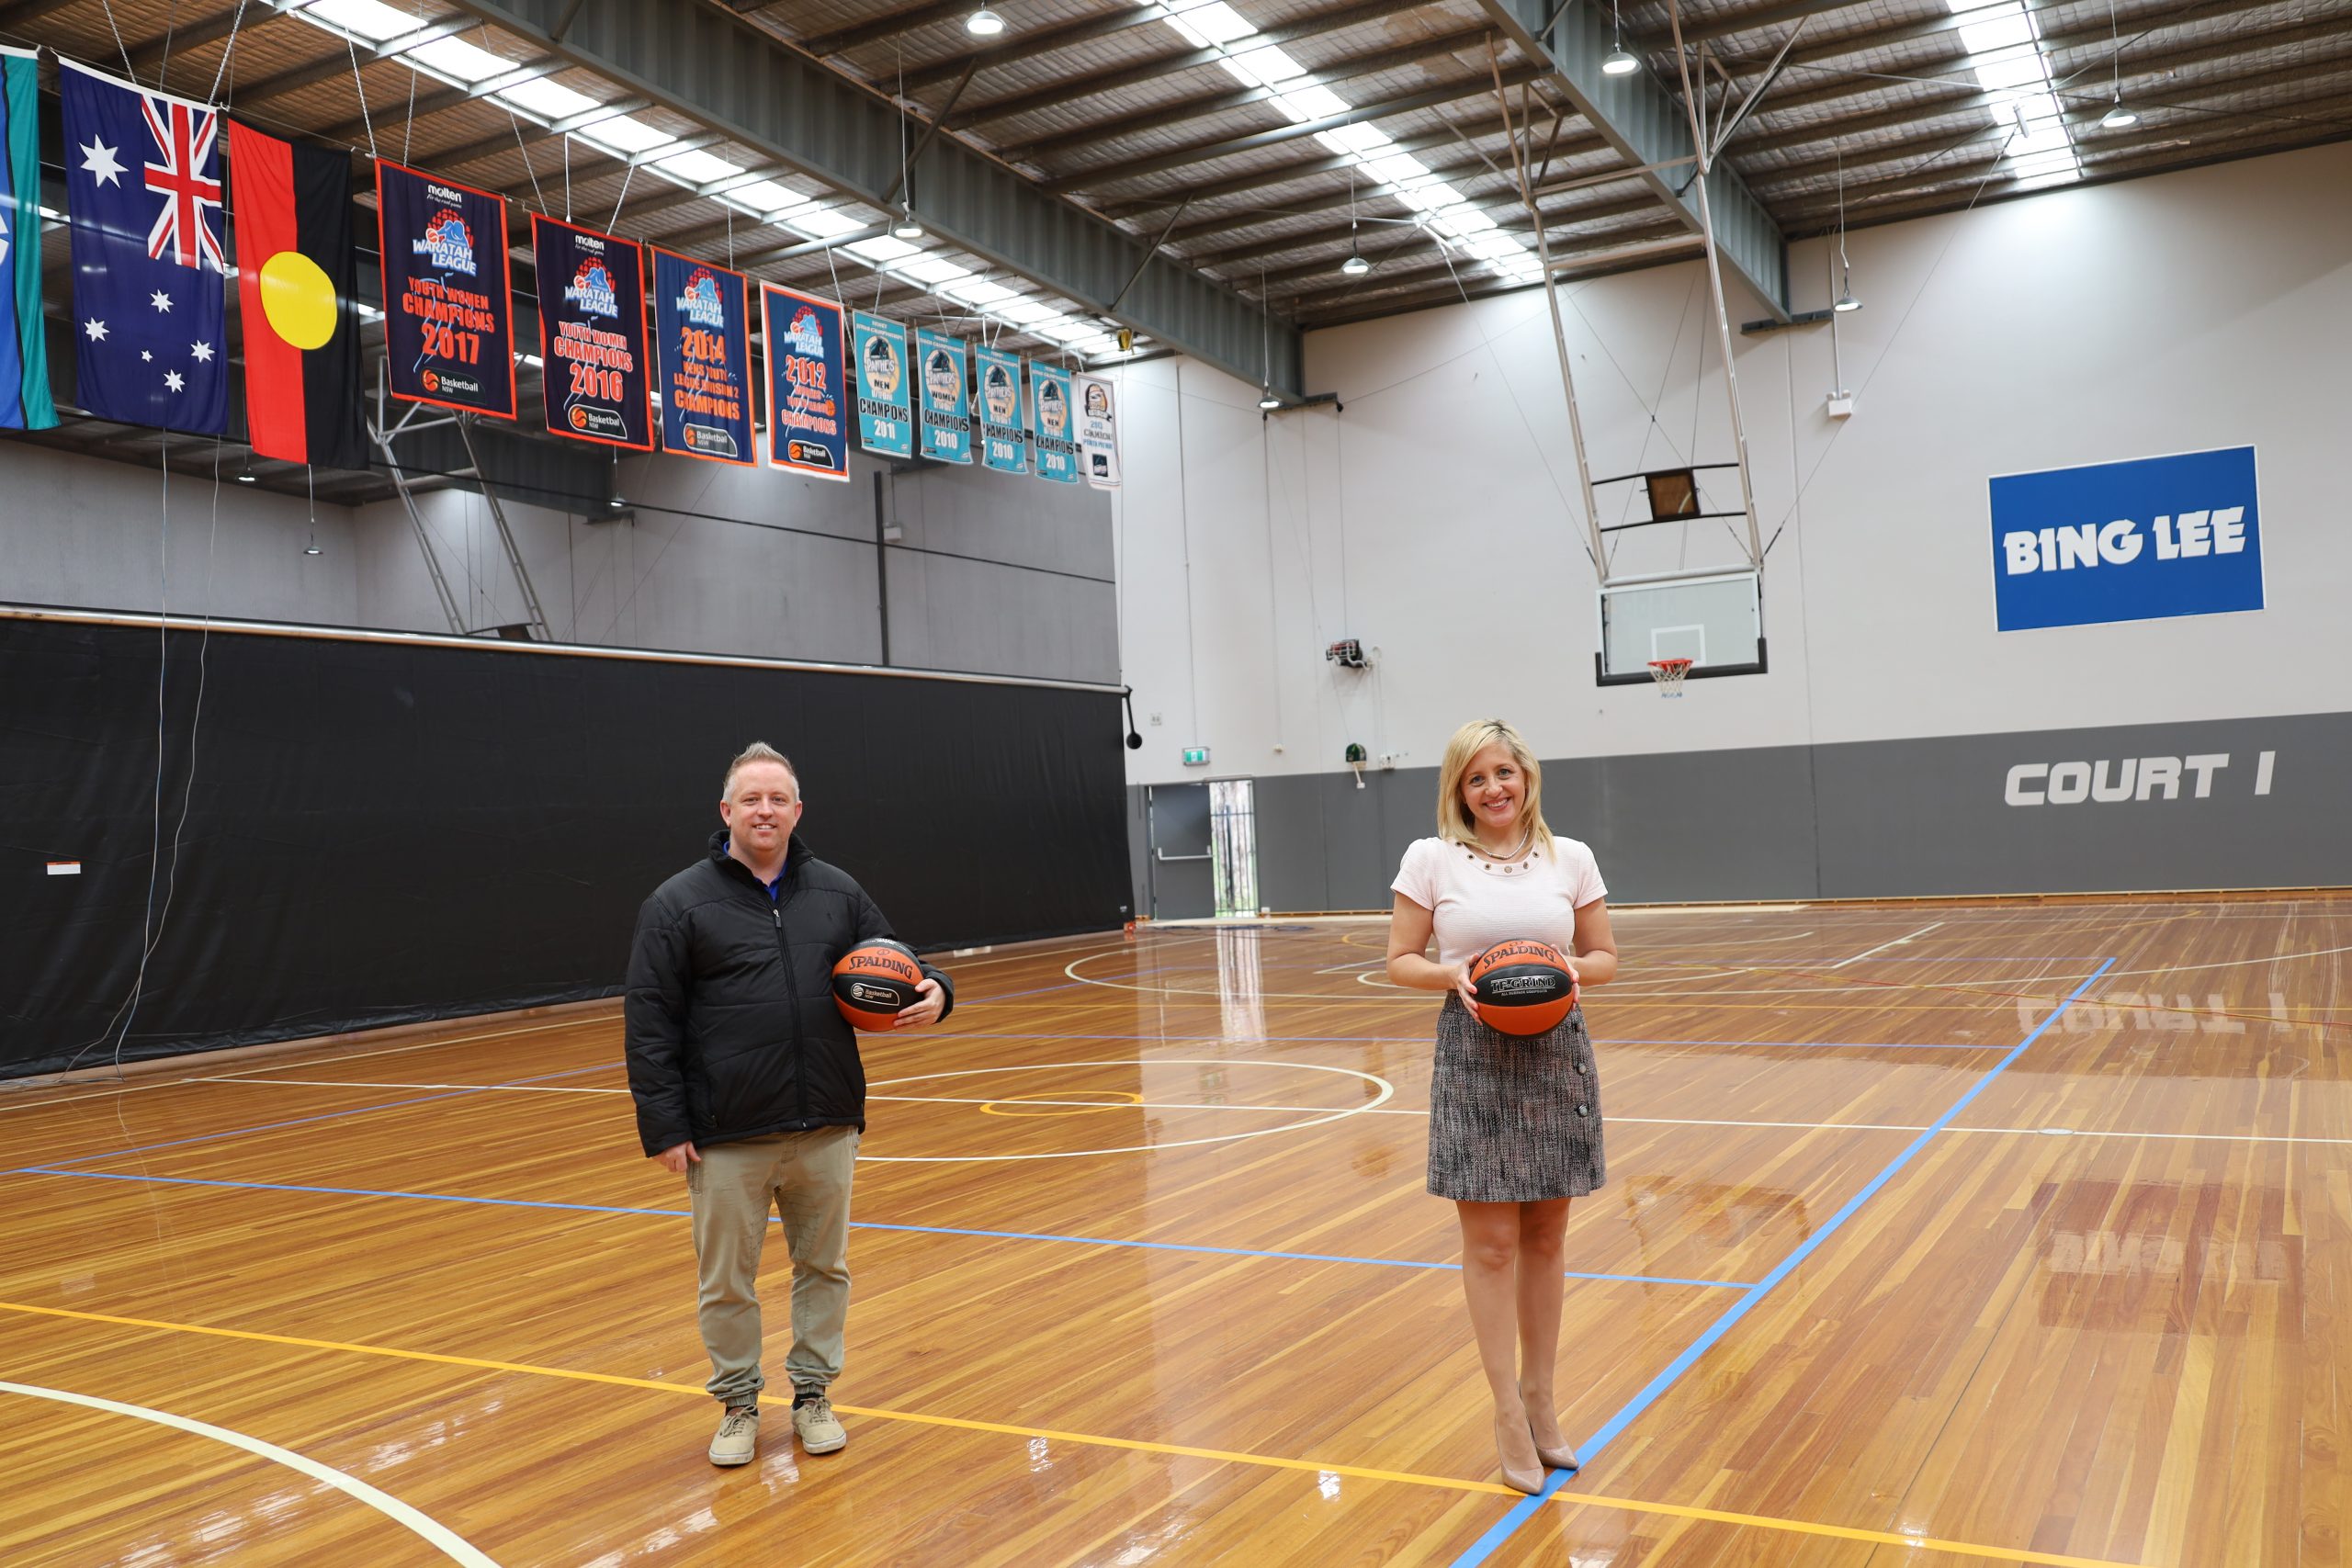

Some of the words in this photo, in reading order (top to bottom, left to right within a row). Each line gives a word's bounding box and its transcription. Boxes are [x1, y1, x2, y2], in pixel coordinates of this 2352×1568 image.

[427, 184, 462, 203] molten
[413, 239, 473, 261] WARATAH
[574, 234, 605, 251] molten
[432, 252, 477, 276] LEAGUE
[408, 276, 446, 301] YOUTH
[446, 287, 490, 310] WOMEN
[564, 286, 615, 305] WARATAH
[402, 291, 495, 333] CHAMPIONS
[580, 298, 618, 320] LEAGUE
[689, 309, 724, 328] LEAGUE
[421, 322, 480, 366] 2017
[559, 321, 592, 343] YOUTH
[592, 329, 628, 351] WOMEN
[681, 326, 727, 366] 2014
[554, 336, 633, 373] CHAMPIONS
[440, 376, 479, 392] Basketball
[569, 363, 624, 402] 2016
[786, 355, 826, 389] 2012
[441, 386, 454, 394] NSW
[932, 390, 956, 402] WOMEN
[674, 389, 741, 422] CHAMPIONS
[781, 409, 837, 436] CHAMPIONS
[874, 419, 896, 440] 2011
[934, 429, 958, 449] 2010
[992, 441, 1013, 460] 2010
[1046, 453, 1065, 470] 2010
[2003, 519, 2143, 576] BING
[2152, 505, 2246, 561] LEE
[2004, 752, 2230, 807] COURT
[848, 955, 914, 980] SPALDING
[1482, 945, 1555, 970] SPALDING
[865, 988, 892, 998] Basketball
